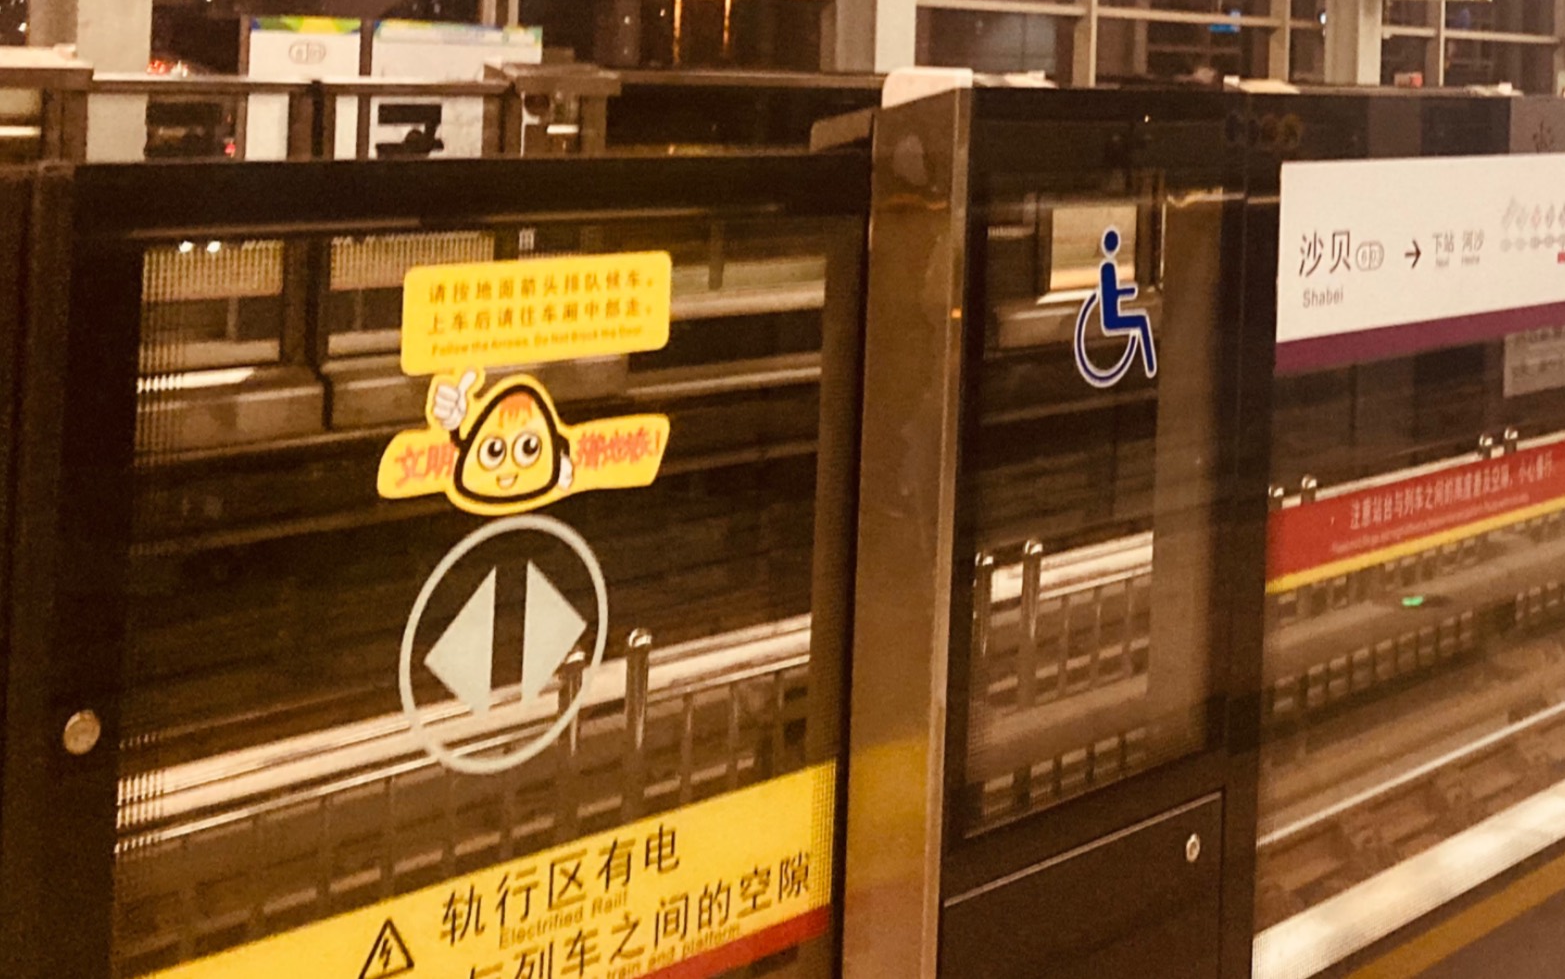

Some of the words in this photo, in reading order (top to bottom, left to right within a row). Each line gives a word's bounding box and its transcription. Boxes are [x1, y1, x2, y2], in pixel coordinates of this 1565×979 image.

[1298, 230, 1352, 278] 沙贝
[1301, 286, 1344, 309] Shabei
[394, 443, 456, 488] 文明
[439, 823, 681, 946] 轨行区有电
[499, 904, 583, 950] Electrified
[648, 945, 675, 967] and
